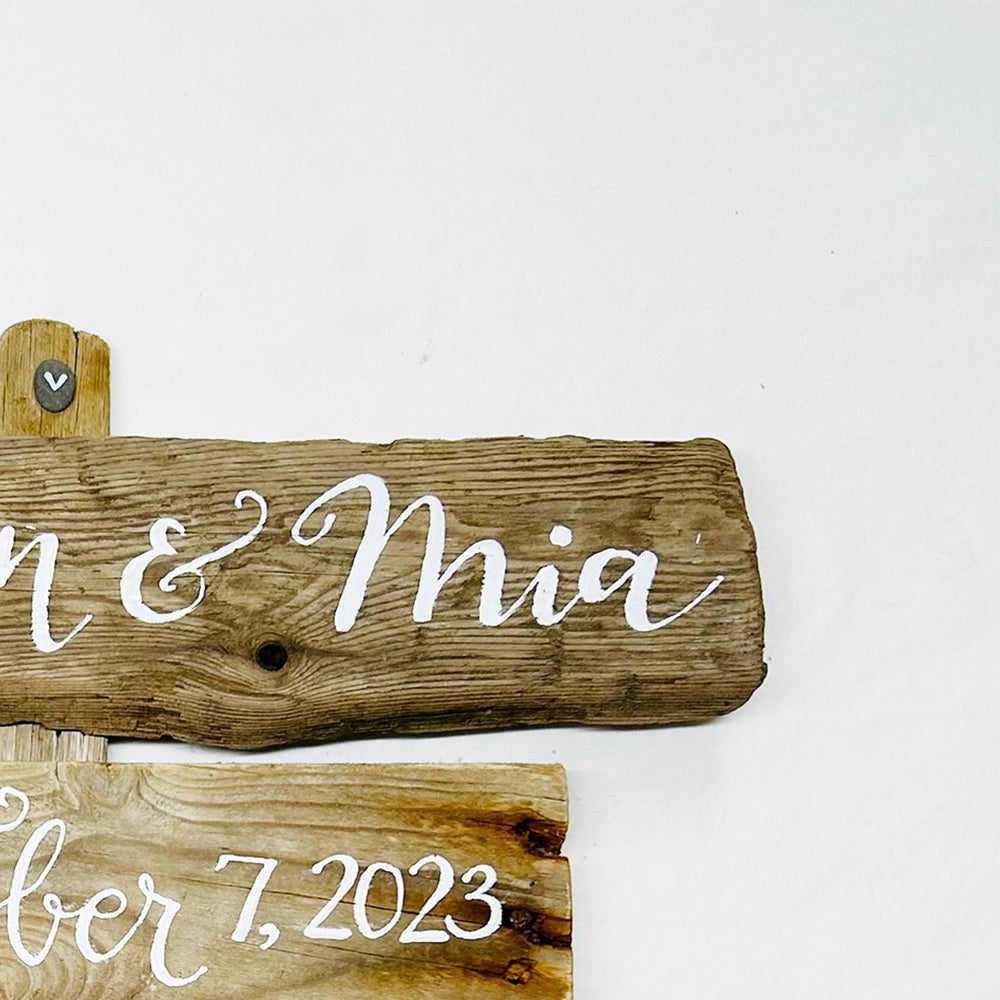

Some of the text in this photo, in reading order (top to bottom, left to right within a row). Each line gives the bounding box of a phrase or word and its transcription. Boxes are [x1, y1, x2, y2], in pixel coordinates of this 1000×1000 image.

[120, 489, 268, 623] &
[291, 472, 725, 633] Mia
[215, 853, 280, 951] 7,
[303, 853, 505, 945] 2023
